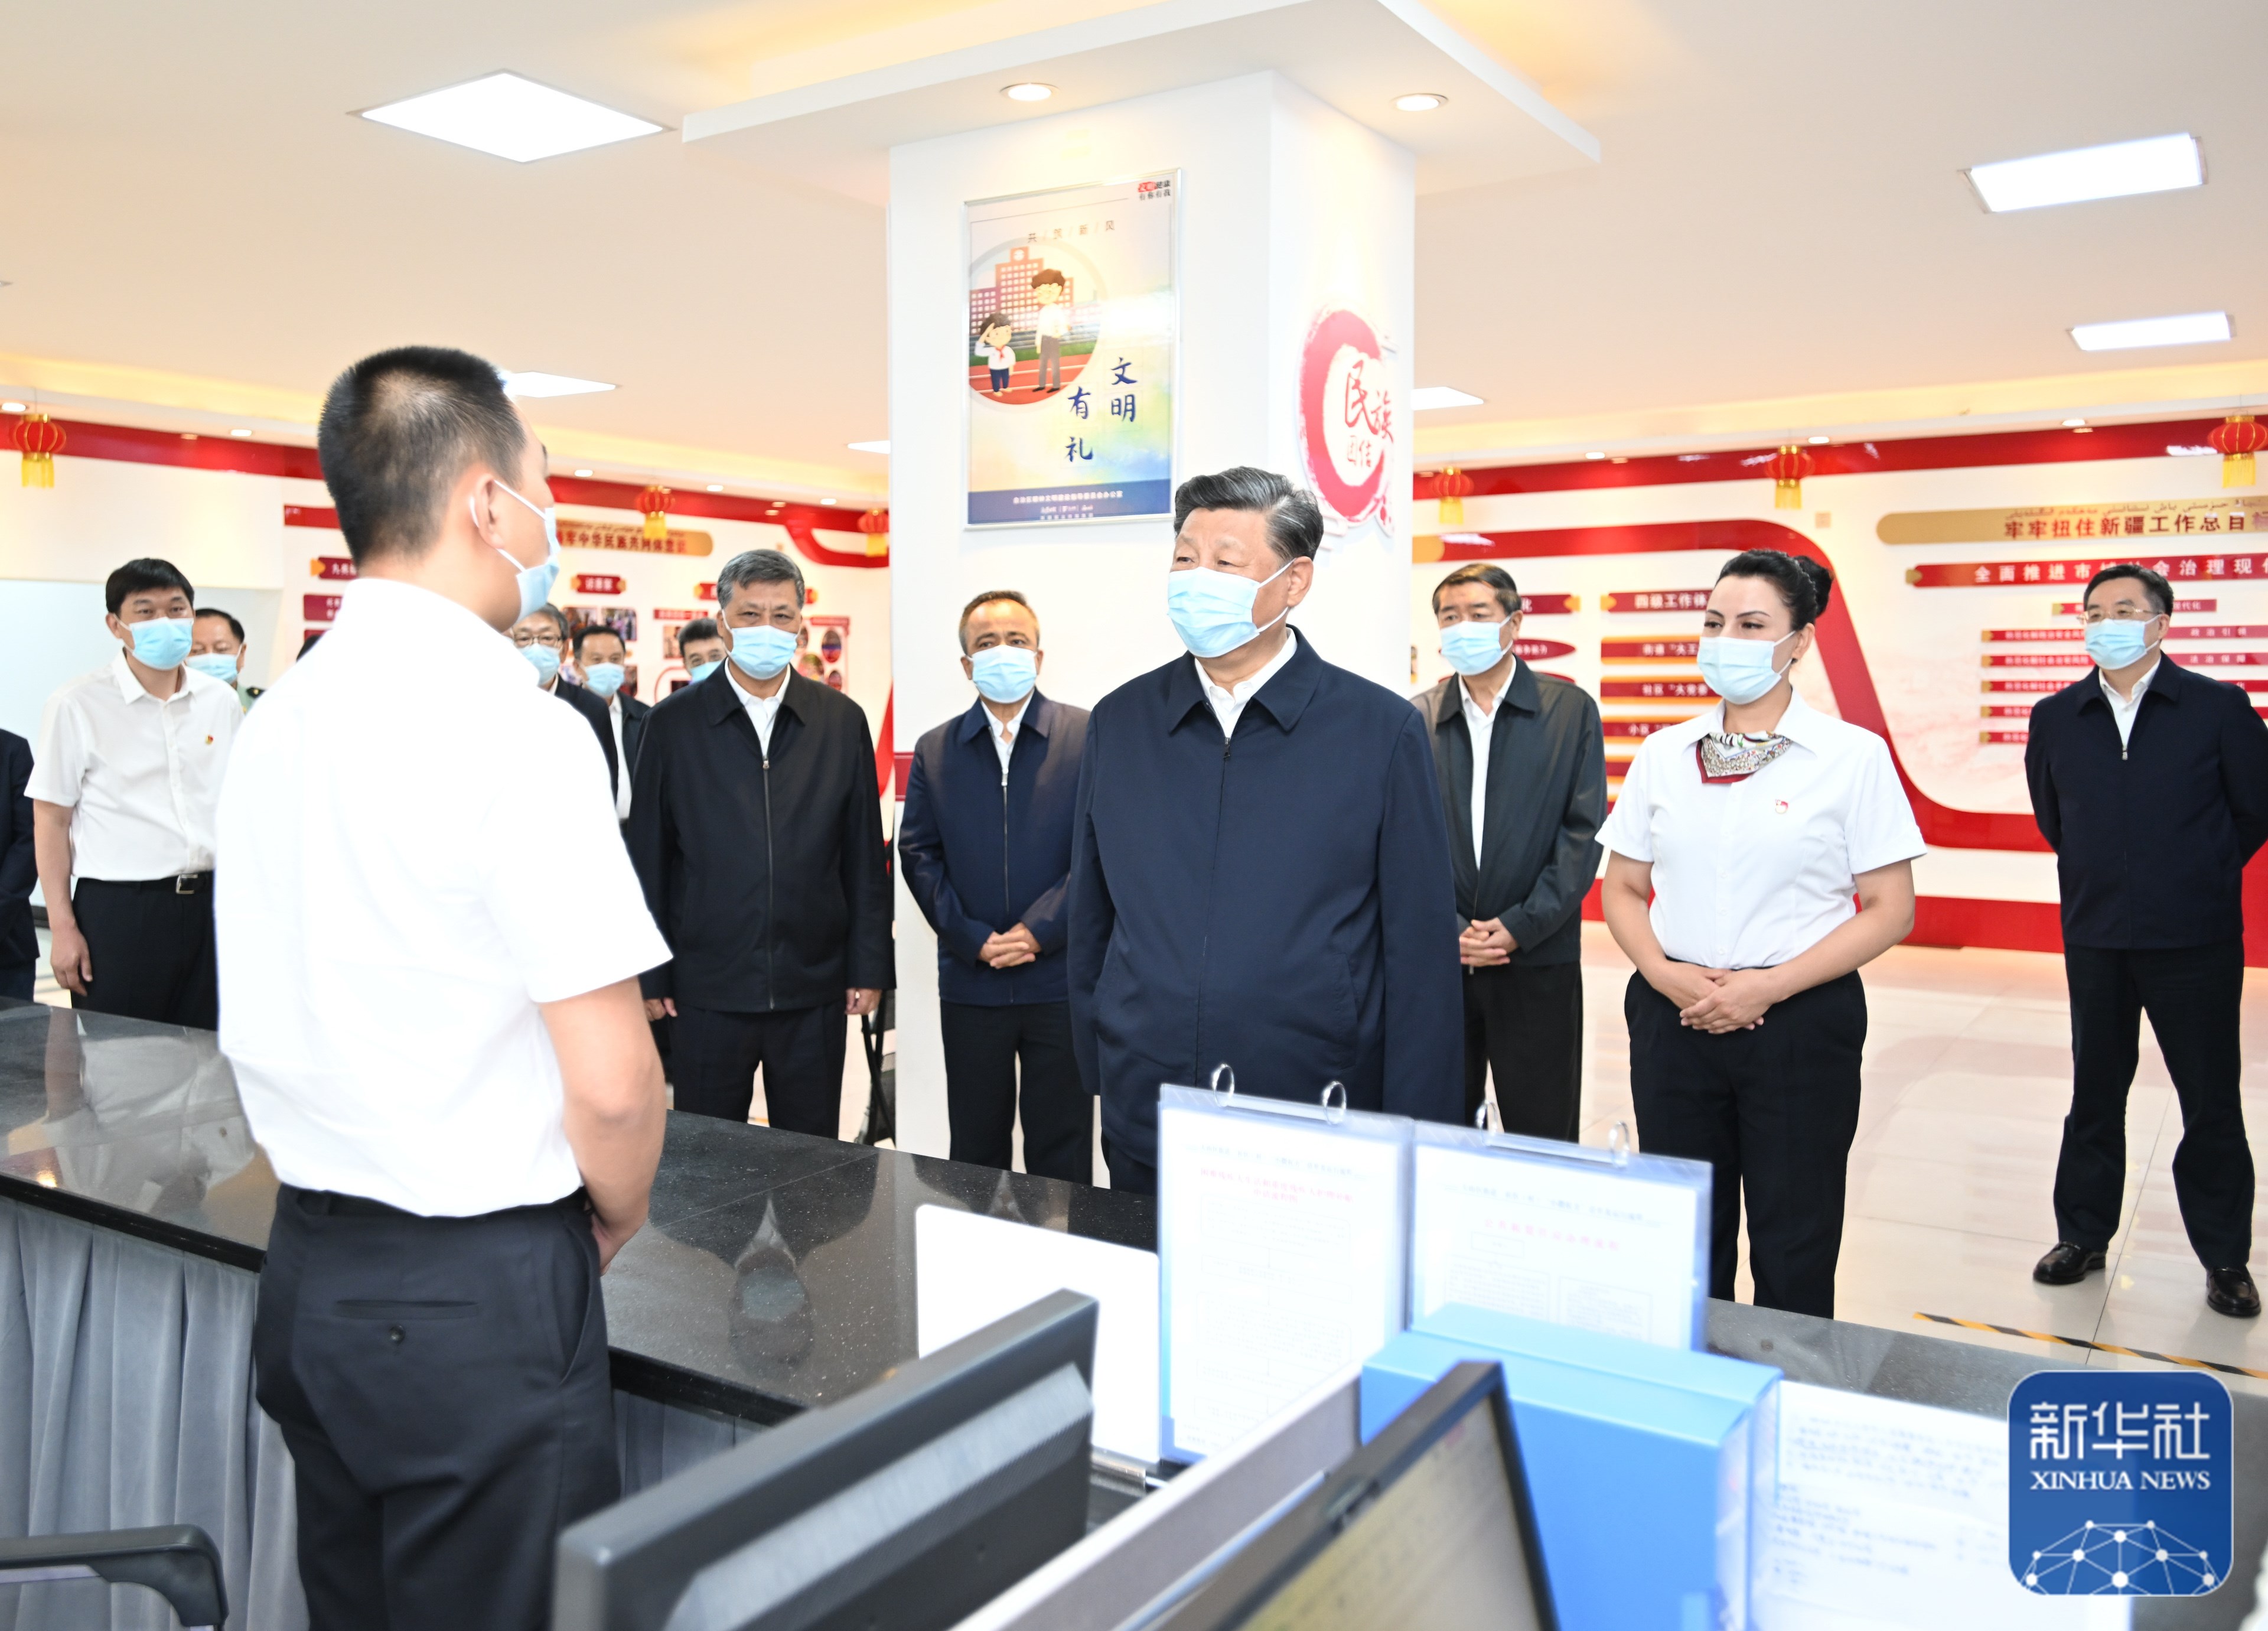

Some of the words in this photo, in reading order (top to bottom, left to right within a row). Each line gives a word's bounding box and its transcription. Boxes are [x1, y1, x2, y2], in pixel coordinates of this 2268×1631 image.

[1111, 357, 1138, 422] 文明
[1345, 360, 1393, 443] 民族
[1065, 386, 1093, 462] 有礼
[1634, 592, 1710, 609] 四级工作体
[1974, 557, 2268, 583] 全面推进市会治理现
